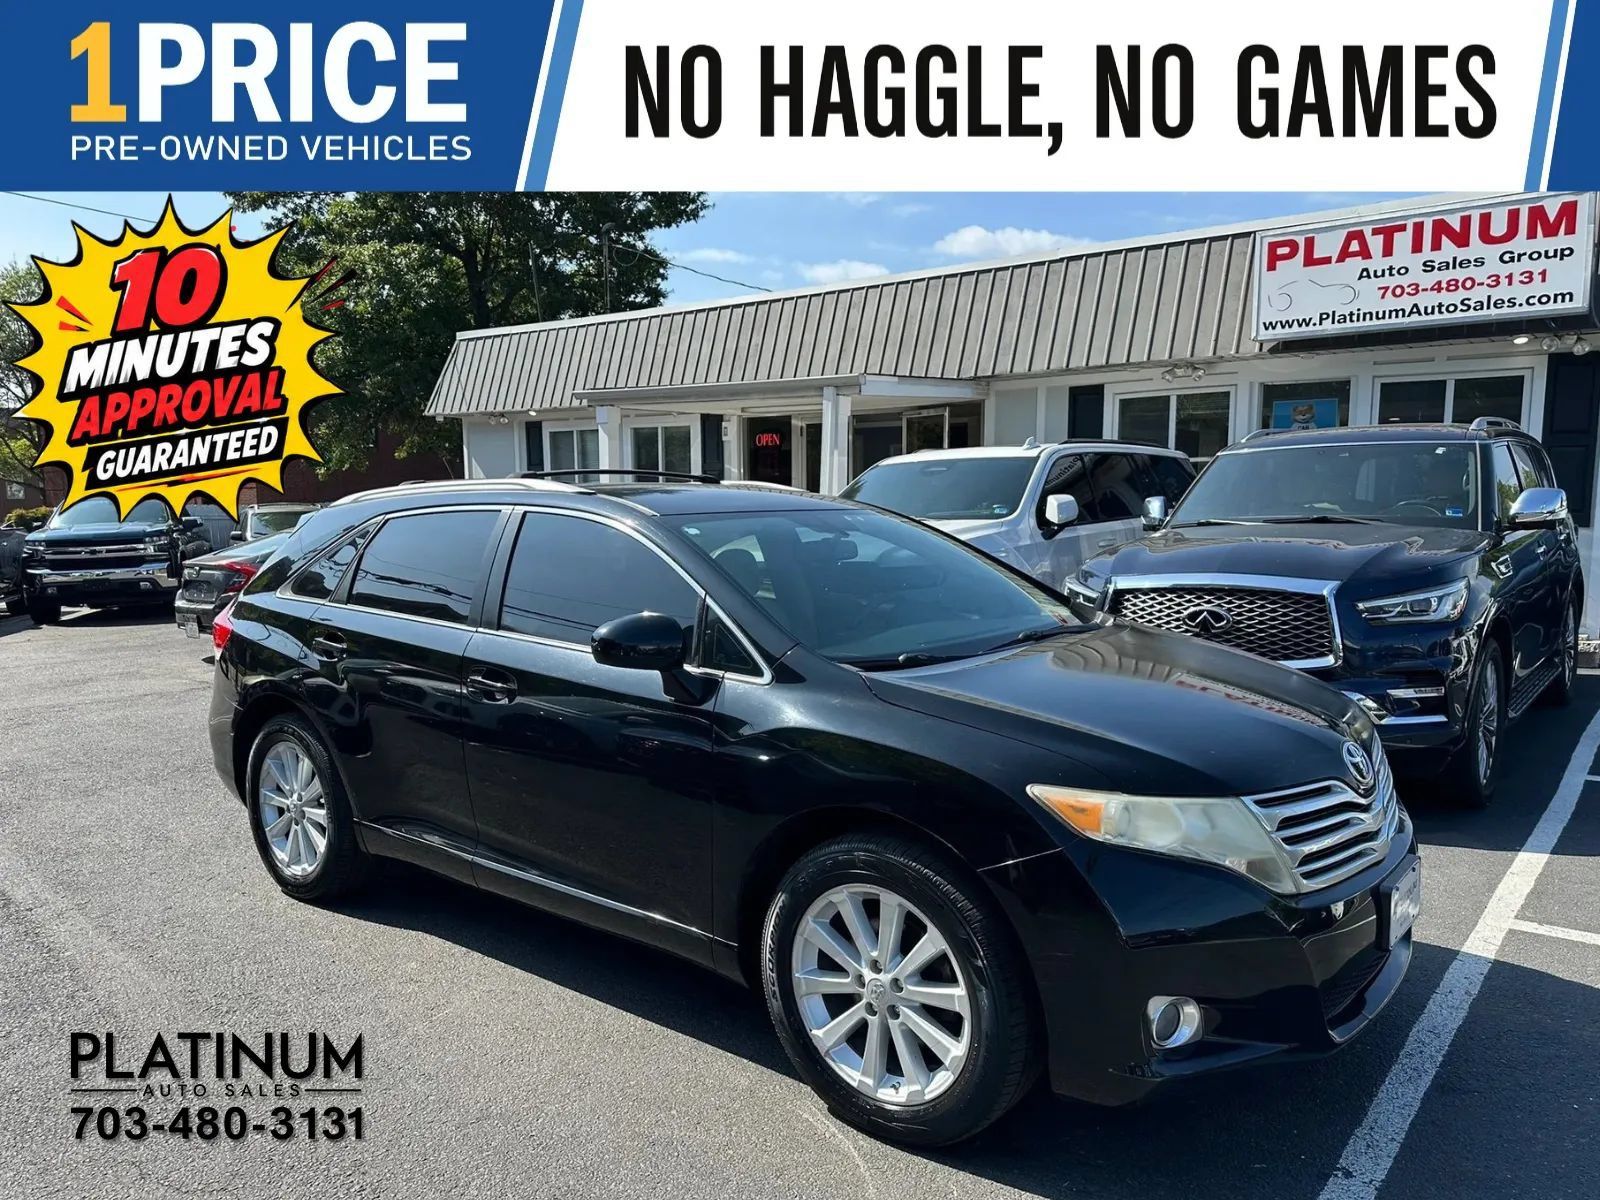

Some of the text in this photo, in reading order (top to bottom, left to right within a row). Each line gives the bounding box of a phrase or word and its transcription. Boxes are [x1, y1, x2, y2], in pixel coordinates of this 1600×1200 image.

[1266, 200, 1578, 272] PLATINUM
[1357, 245, 1576, 281] Auto Sales Group
[1377, 268, 1549, 300] 703-480-3131
[1262, 290, 1575, 331] www.PlatinumAutoSales.com
[755, 433, 781, 447] OPEN
